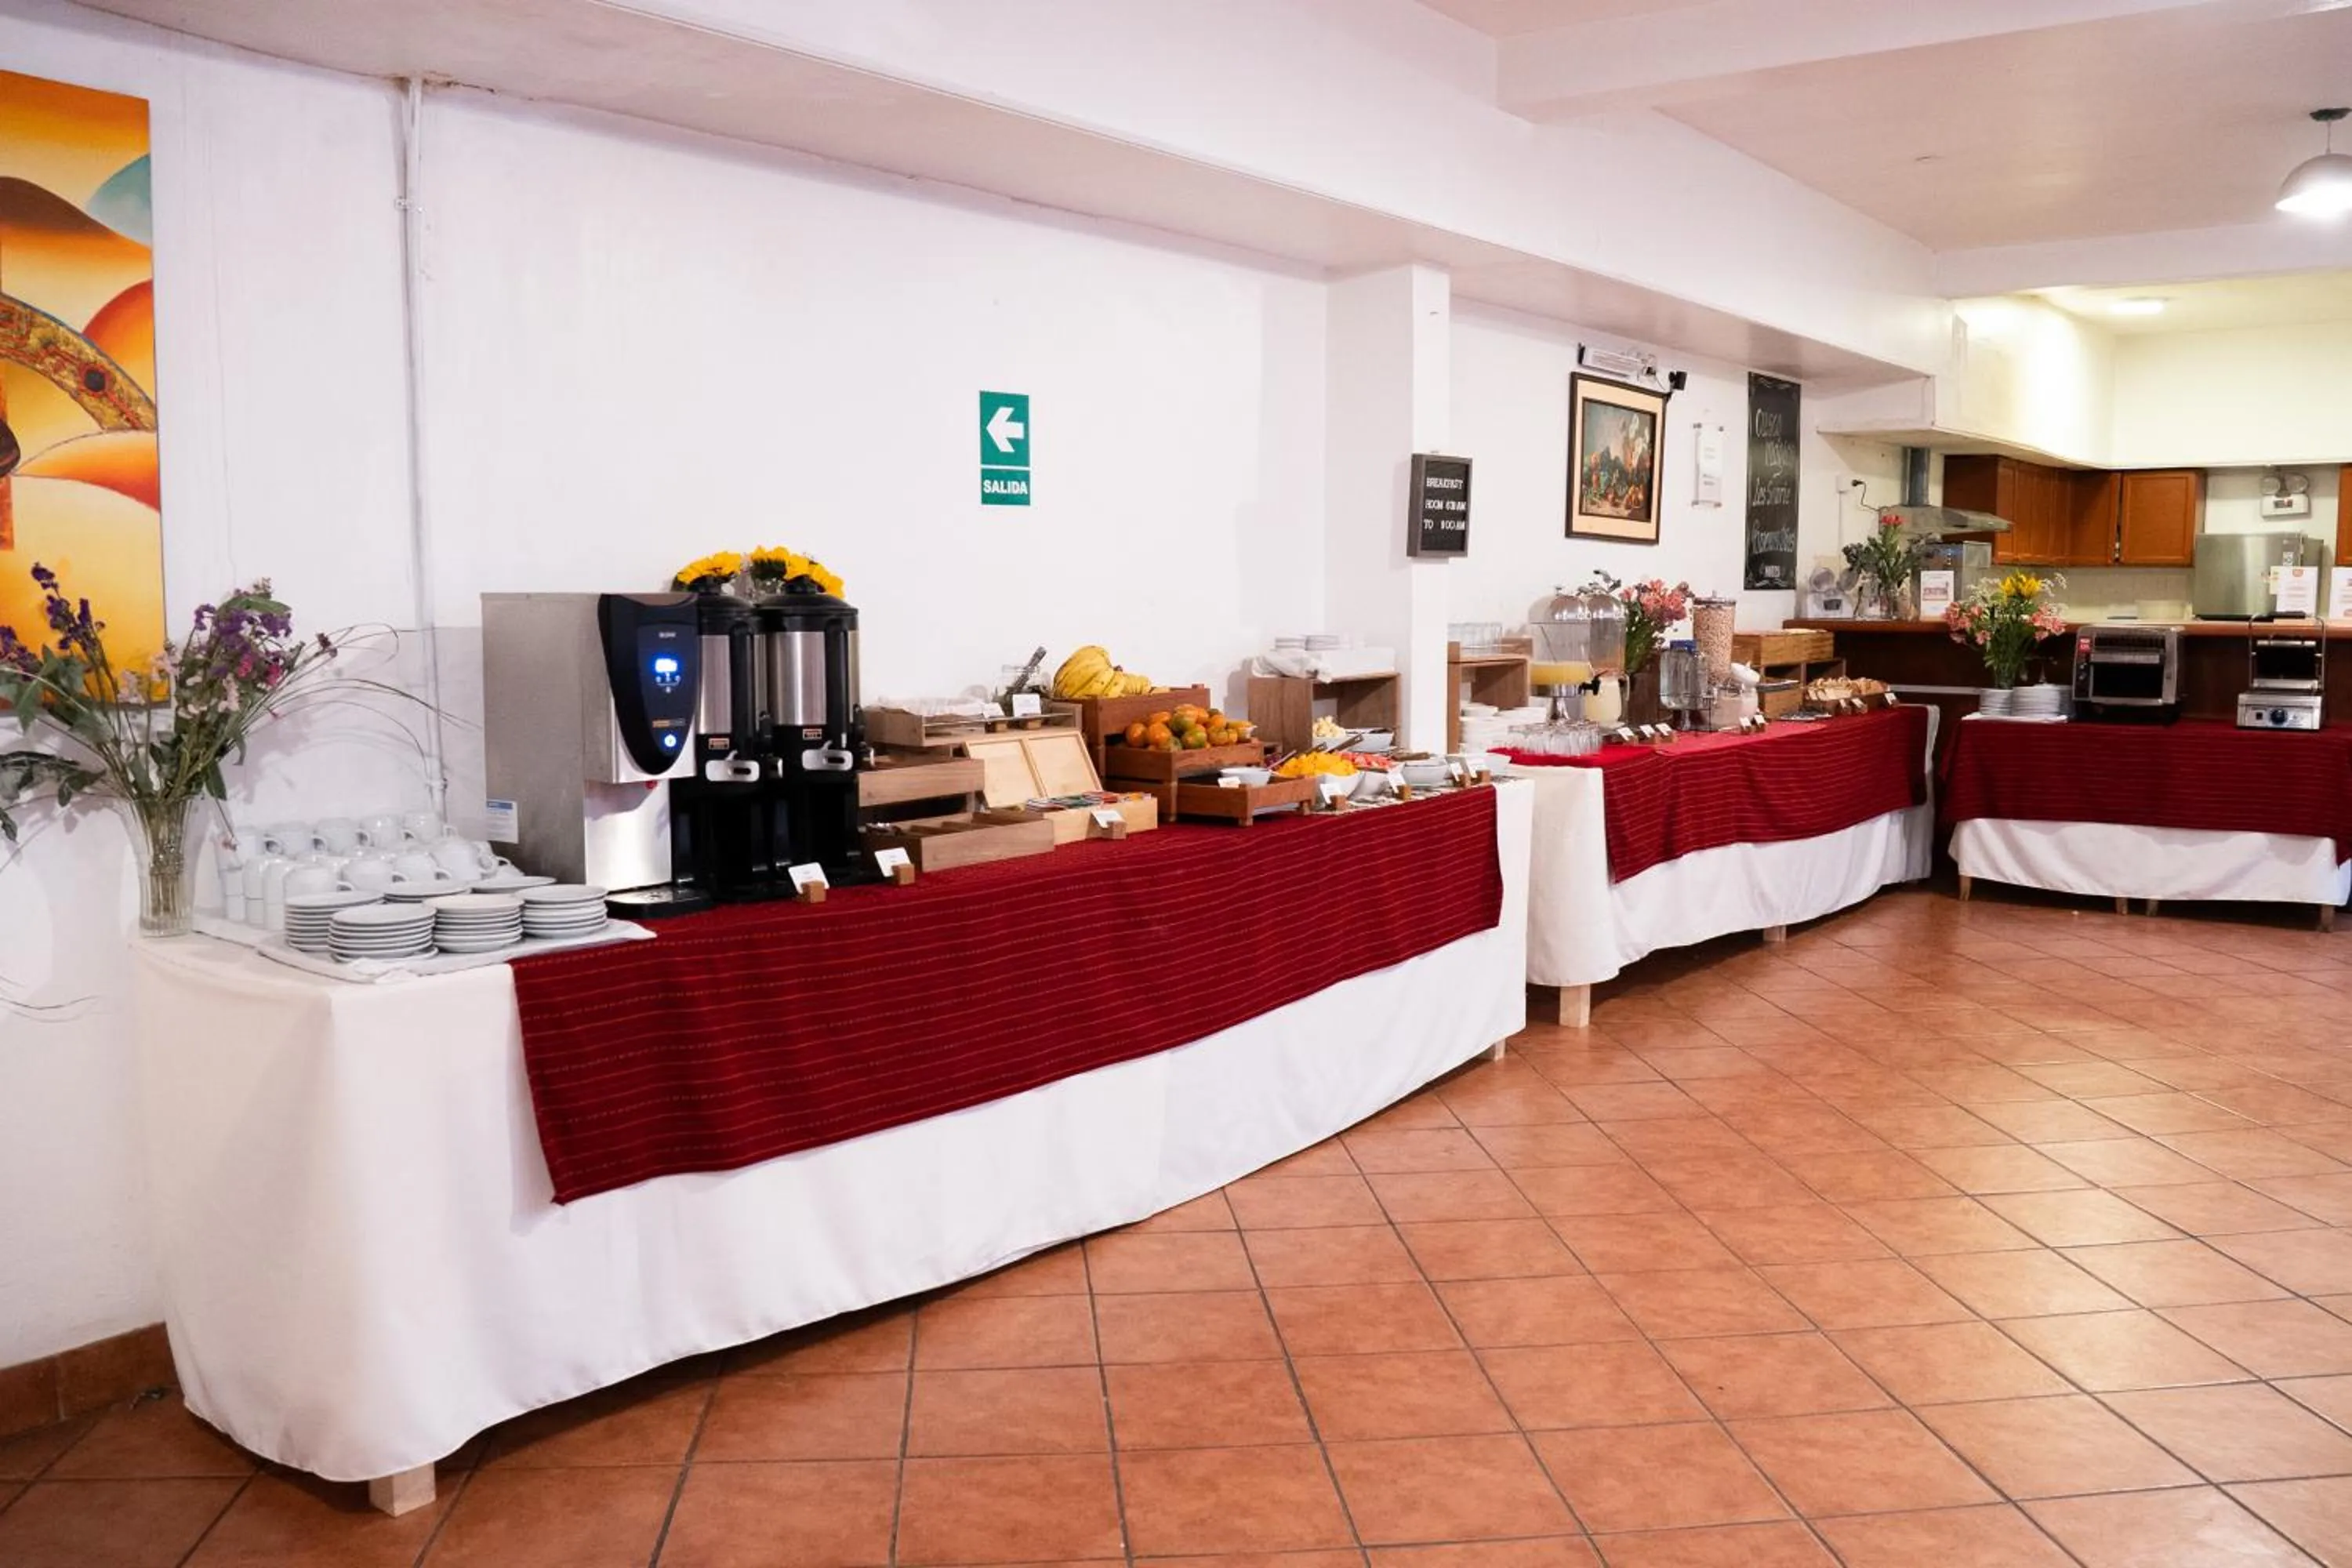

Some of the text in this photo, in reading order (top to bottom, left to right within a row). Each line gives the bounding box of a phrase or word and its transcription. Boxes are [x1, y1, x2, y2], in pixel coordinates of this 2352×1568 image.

[983, 480, 1028, 495] SALIDA
[1426, 477, 1464, 489] BREAKFAST
[1423, 518, 1434, 530] TO
